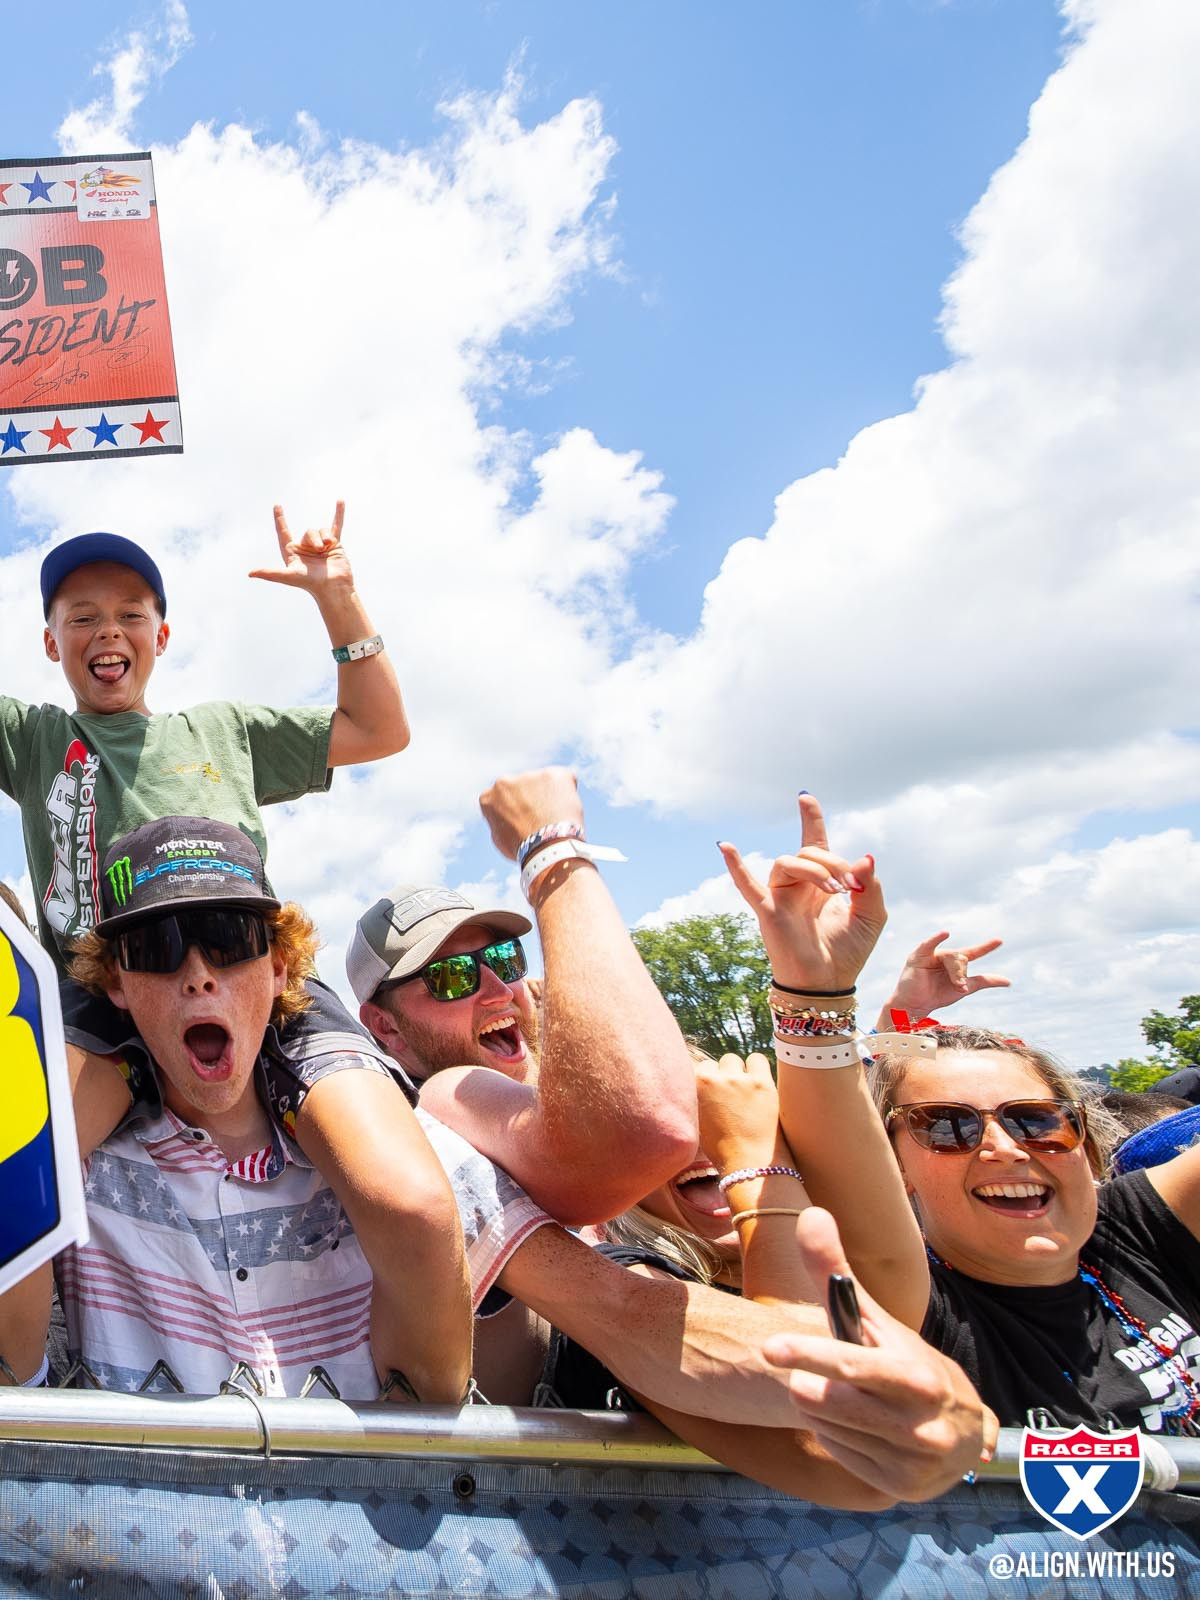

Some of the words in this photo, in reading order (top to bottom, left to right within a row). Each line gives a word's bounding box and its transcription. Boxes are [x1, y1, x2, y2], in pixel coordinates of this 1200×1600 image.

[97, 190, 140, 198] HONDA
[155, 838, 227, 855] MONSTER
[44, 771, 78, 937] MCR
[167, 849, 218, 859] ENERGY
[167, 871, 226, 884] Championship
[779, 1017, 809, 1030] PIT
